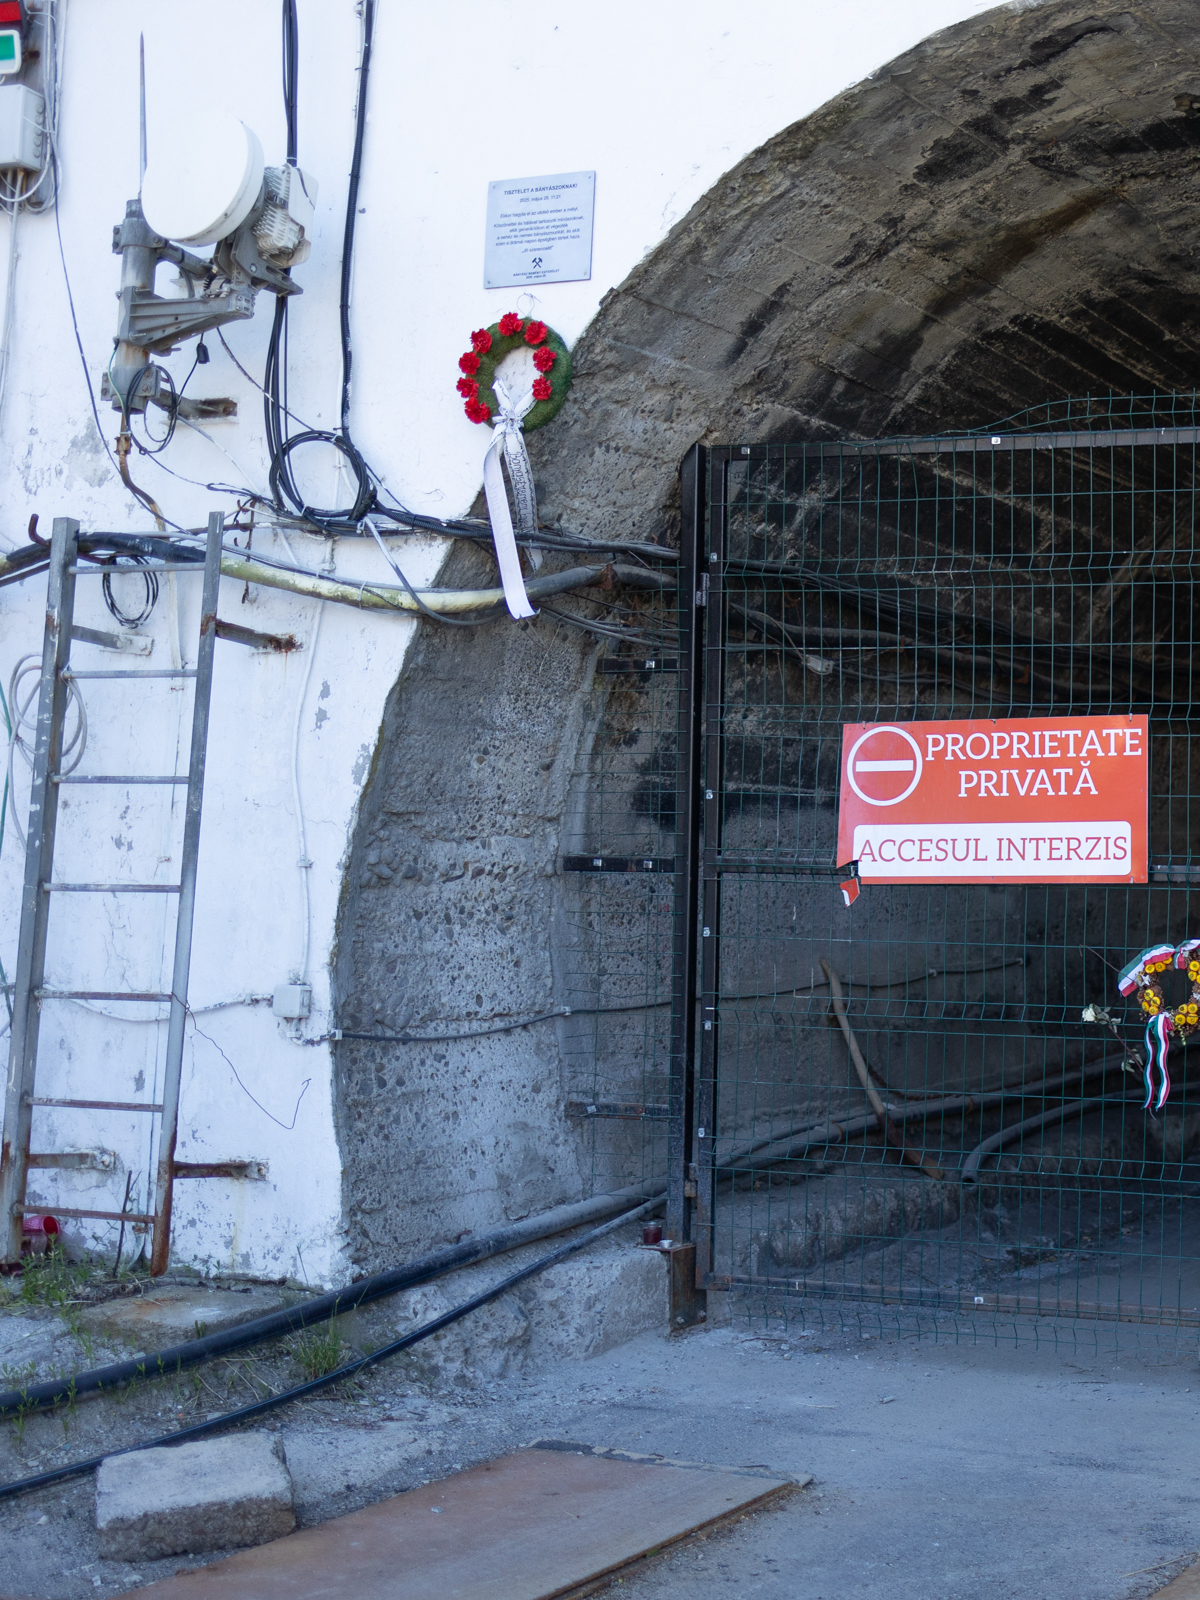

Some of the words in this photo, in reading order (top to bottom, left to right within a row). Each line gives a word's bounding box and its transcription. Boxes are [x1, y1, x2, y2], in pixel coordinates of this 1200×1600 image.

[535, 184, 577, 192] BÁNYÁSZOKNAK!
[926, 728, 1142, 761] PROPRIETATE
[958, 760, 1098, 797] PRIVATĂ
[858, 838, 988, 862] ACCESUL
[996, 836, 1127, 861] INTERZIS
